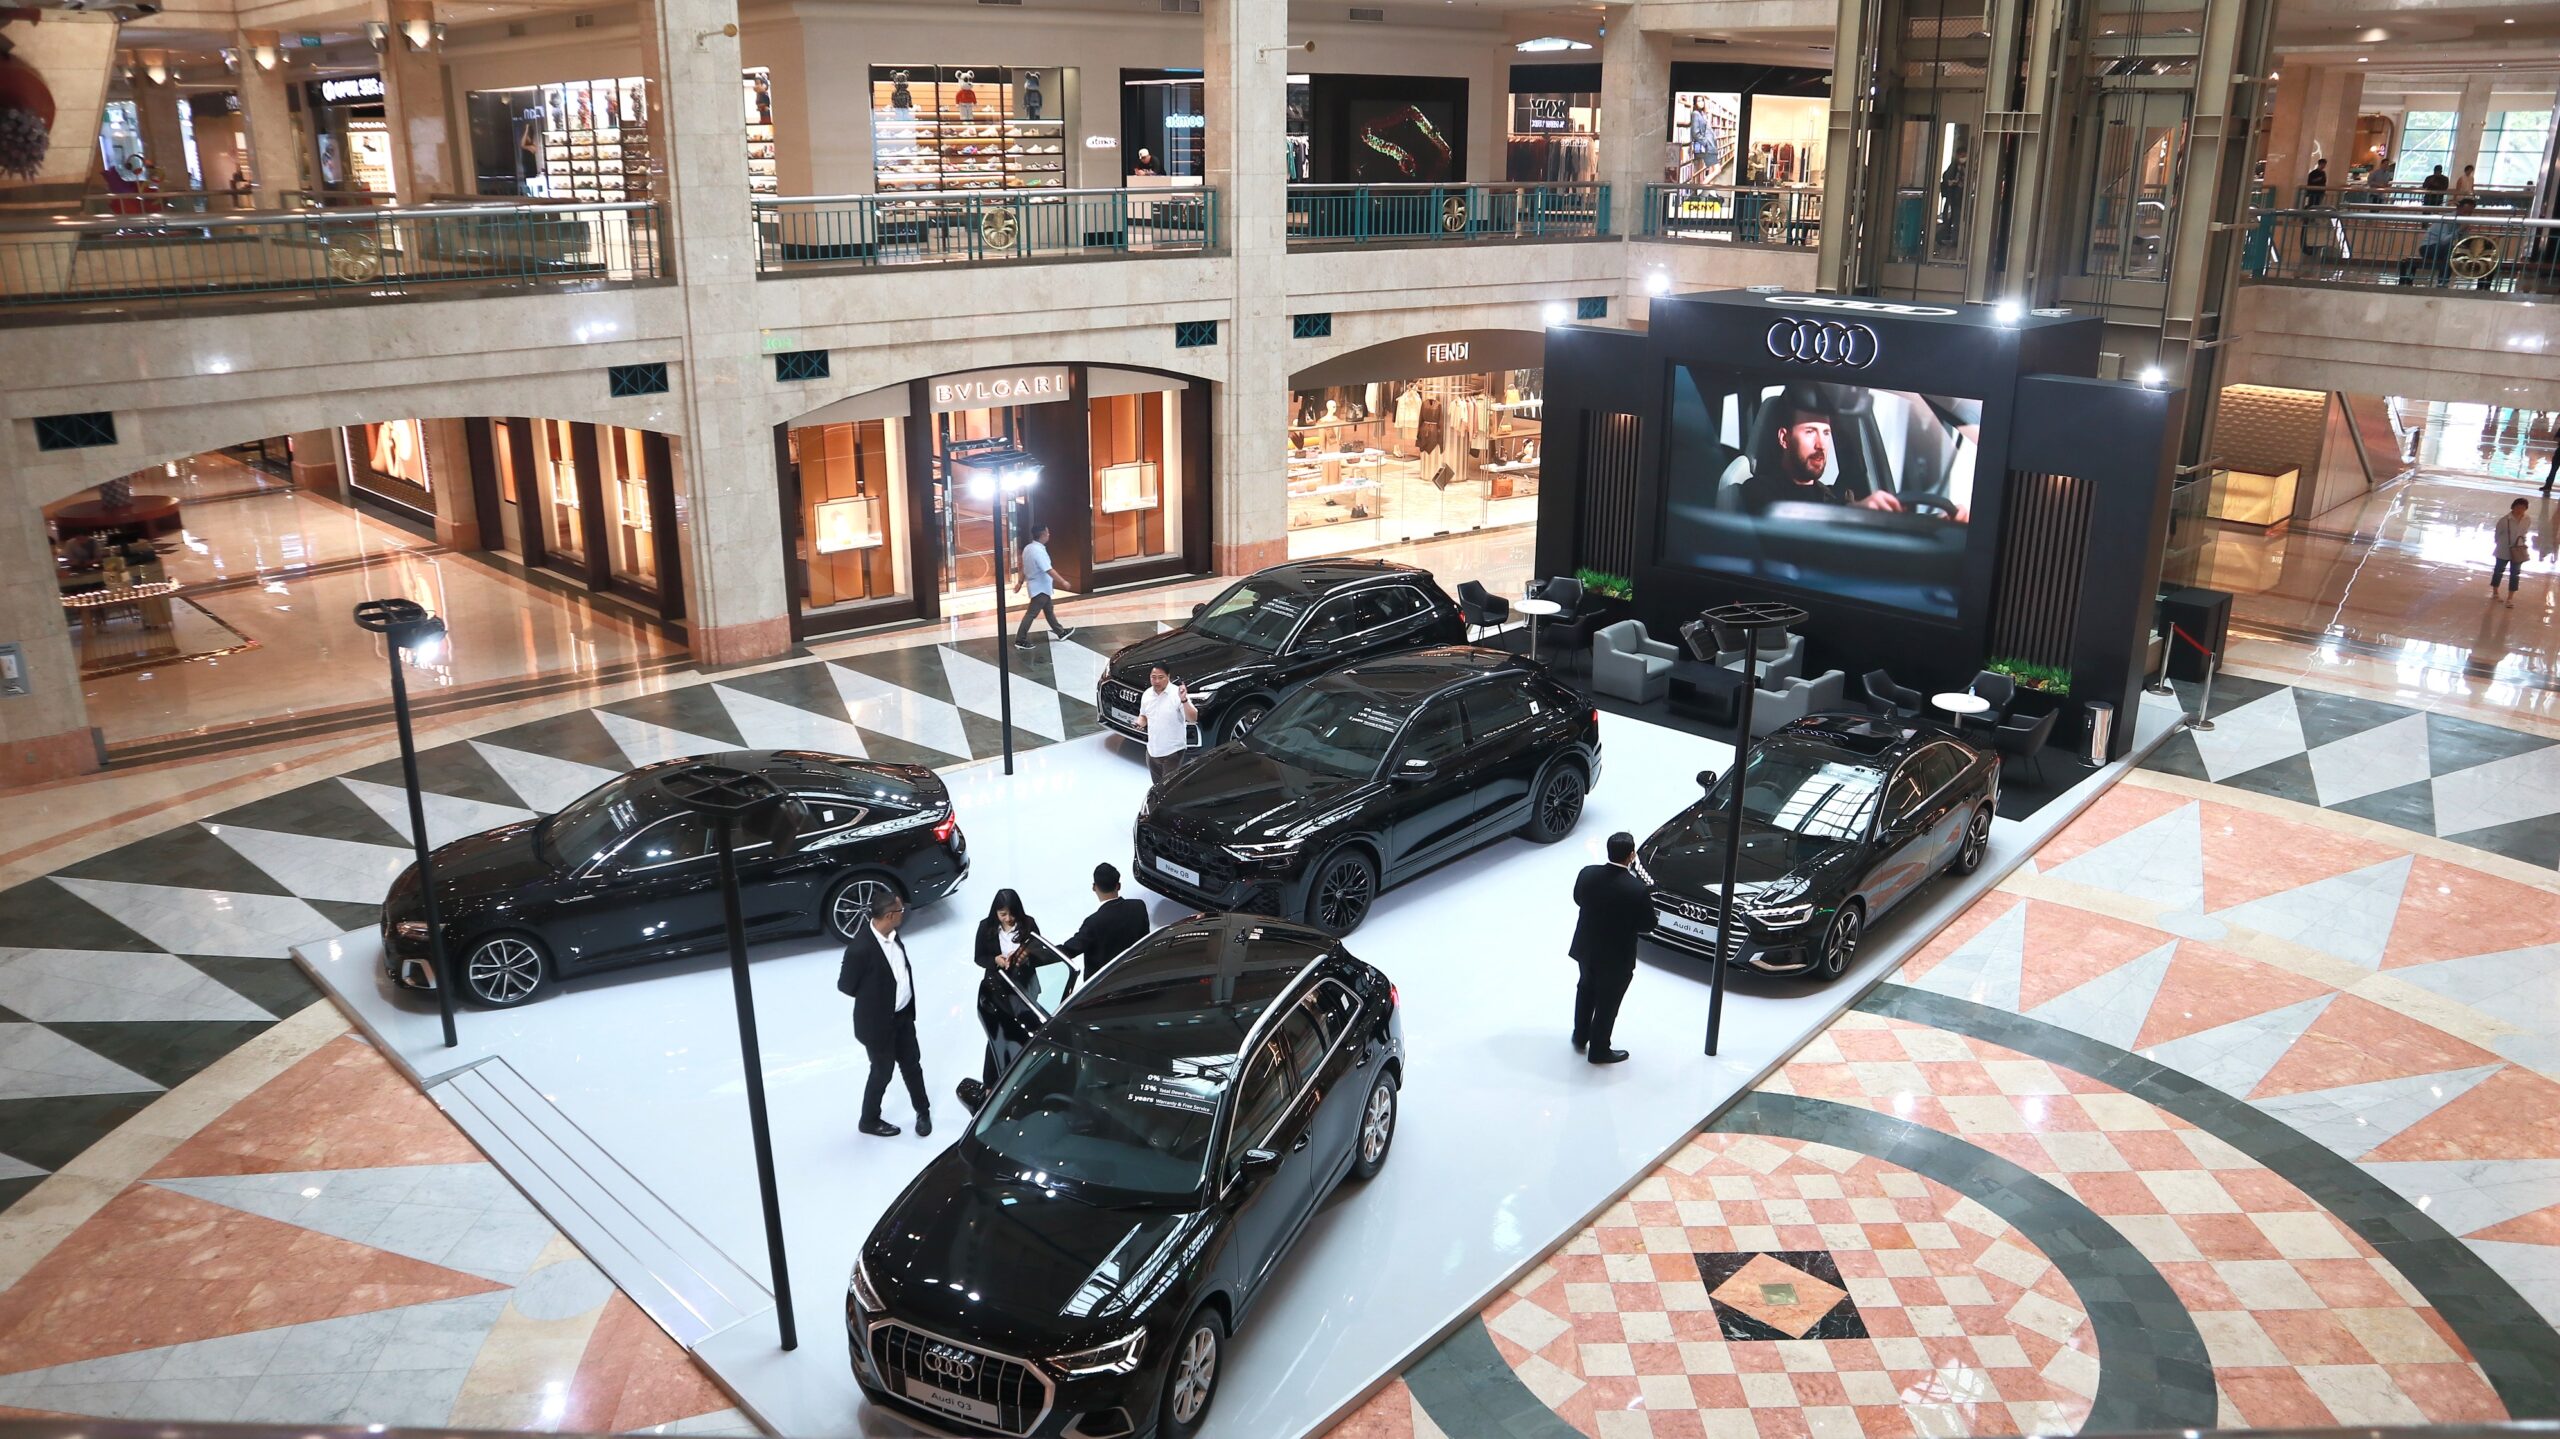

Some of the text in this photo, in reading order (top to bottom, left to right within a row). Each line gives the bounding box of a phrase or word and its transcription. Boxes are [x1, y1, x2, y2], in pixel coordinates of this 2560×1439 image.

[1165, 113, 1205, 128] atmos
[1427, 342, 1470, 363] FENDI
[935, 374, 1064, 404] BVLGARI
[1165, 864, 1179, 874] New
[1673, 921, 1704, 935] Audi A4
[1147, 1074, 1160, 1082] 0%
[1140, 1084, 1157, 1092] 15%
[1184, 1091, 1206, 1100] Payment
[1133, 1095, 1154, 1103] years
[1156, 1098, 1177, 1107] Warranty
[1193, 1104, 1211, 1112] Service
[931, 1392, 972, 1411] Audi Q3
